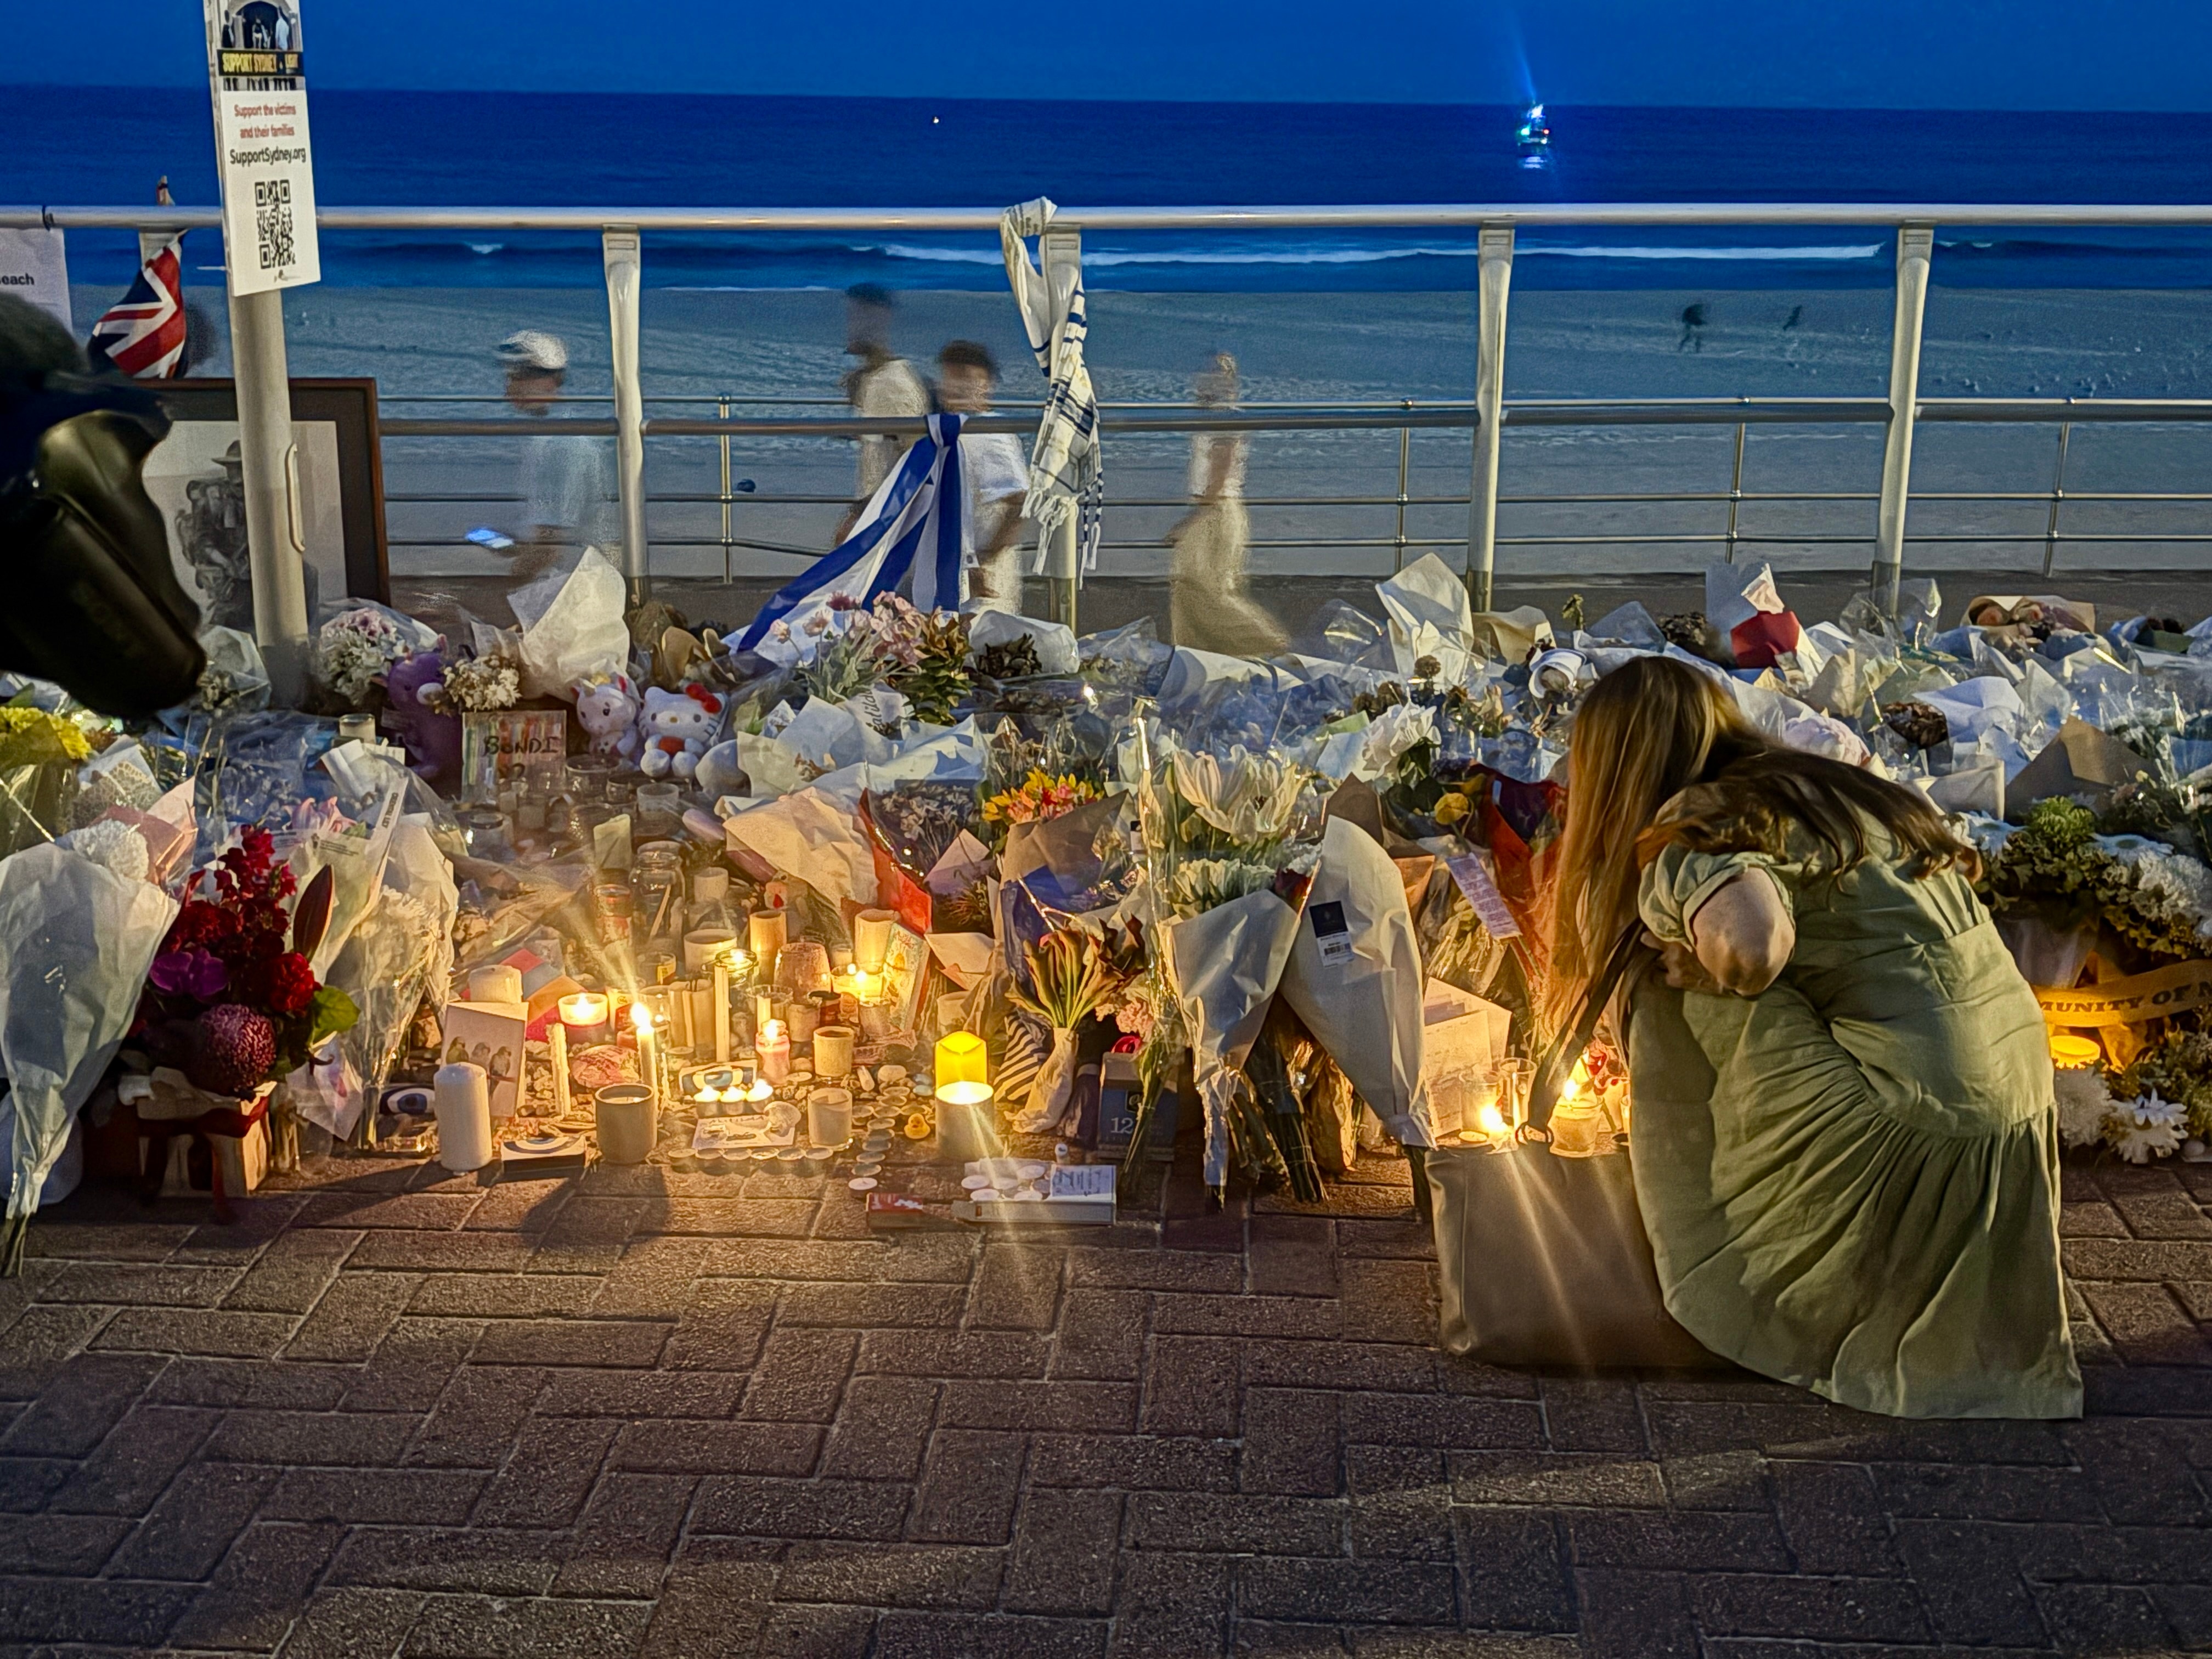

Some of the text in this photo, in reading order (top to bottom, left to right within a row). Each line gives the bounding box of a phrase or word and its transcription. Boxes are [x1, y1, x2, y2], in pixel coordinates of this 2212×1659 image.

[222, 53, 253, 72] SUPPORT
[234, 102, 296, 119] Support the victims
[240, 123, 295, 138] and their families
[230, 145, 306, 167] SupportSydney.org
[0, 272, 35, 285] each
[2152, 984, 2192, 1005] OF
